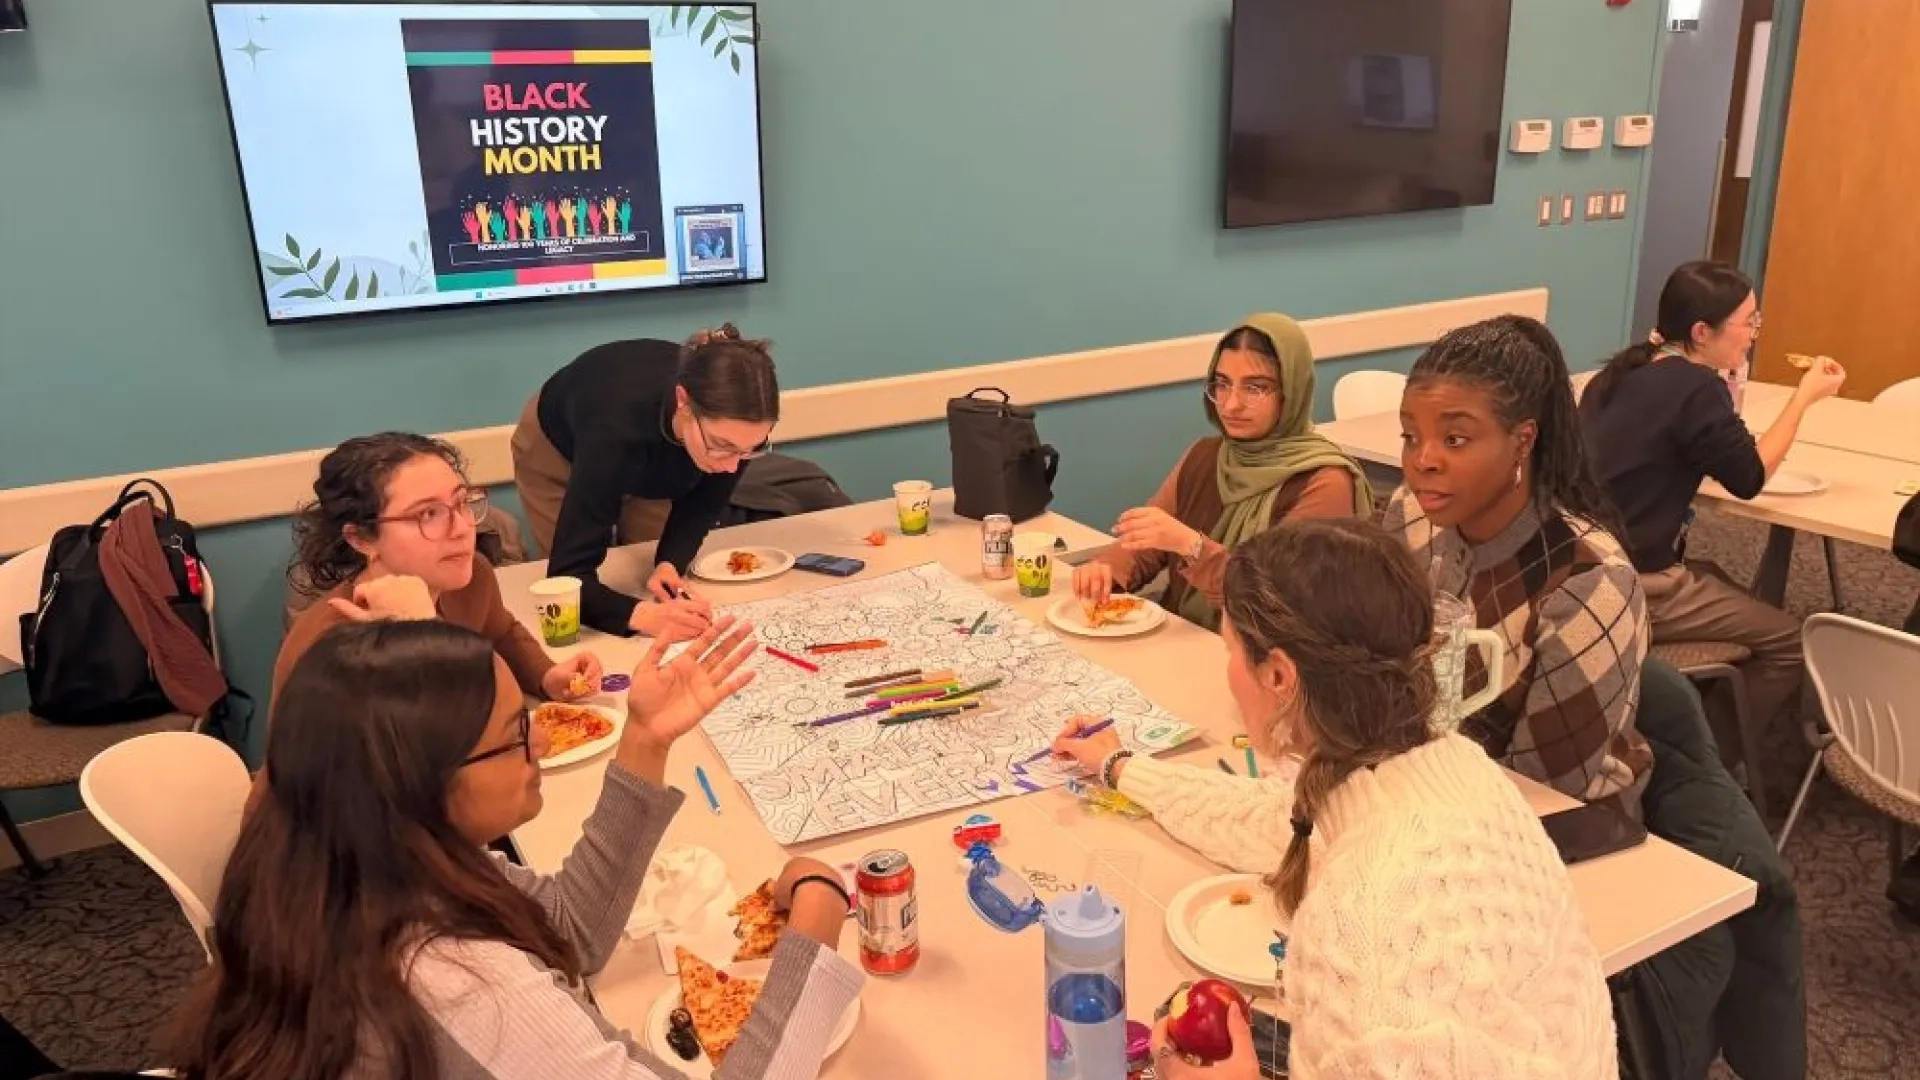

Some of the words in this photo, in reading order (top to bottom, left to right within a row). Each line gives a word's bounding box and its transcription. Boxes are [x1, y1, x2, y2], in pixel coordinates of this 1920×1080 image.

[483, 82, 591, 111] BLACK
[470, 115, 608, 146] HISTORY
[485, 144, 602, 175] MONTH
[536, 238, 559, 248] YEARS
[560, 237, 570, 246] OF
[572, 234, 619, 245] CELEBRATION
[620, 232, 636, 242] AND
